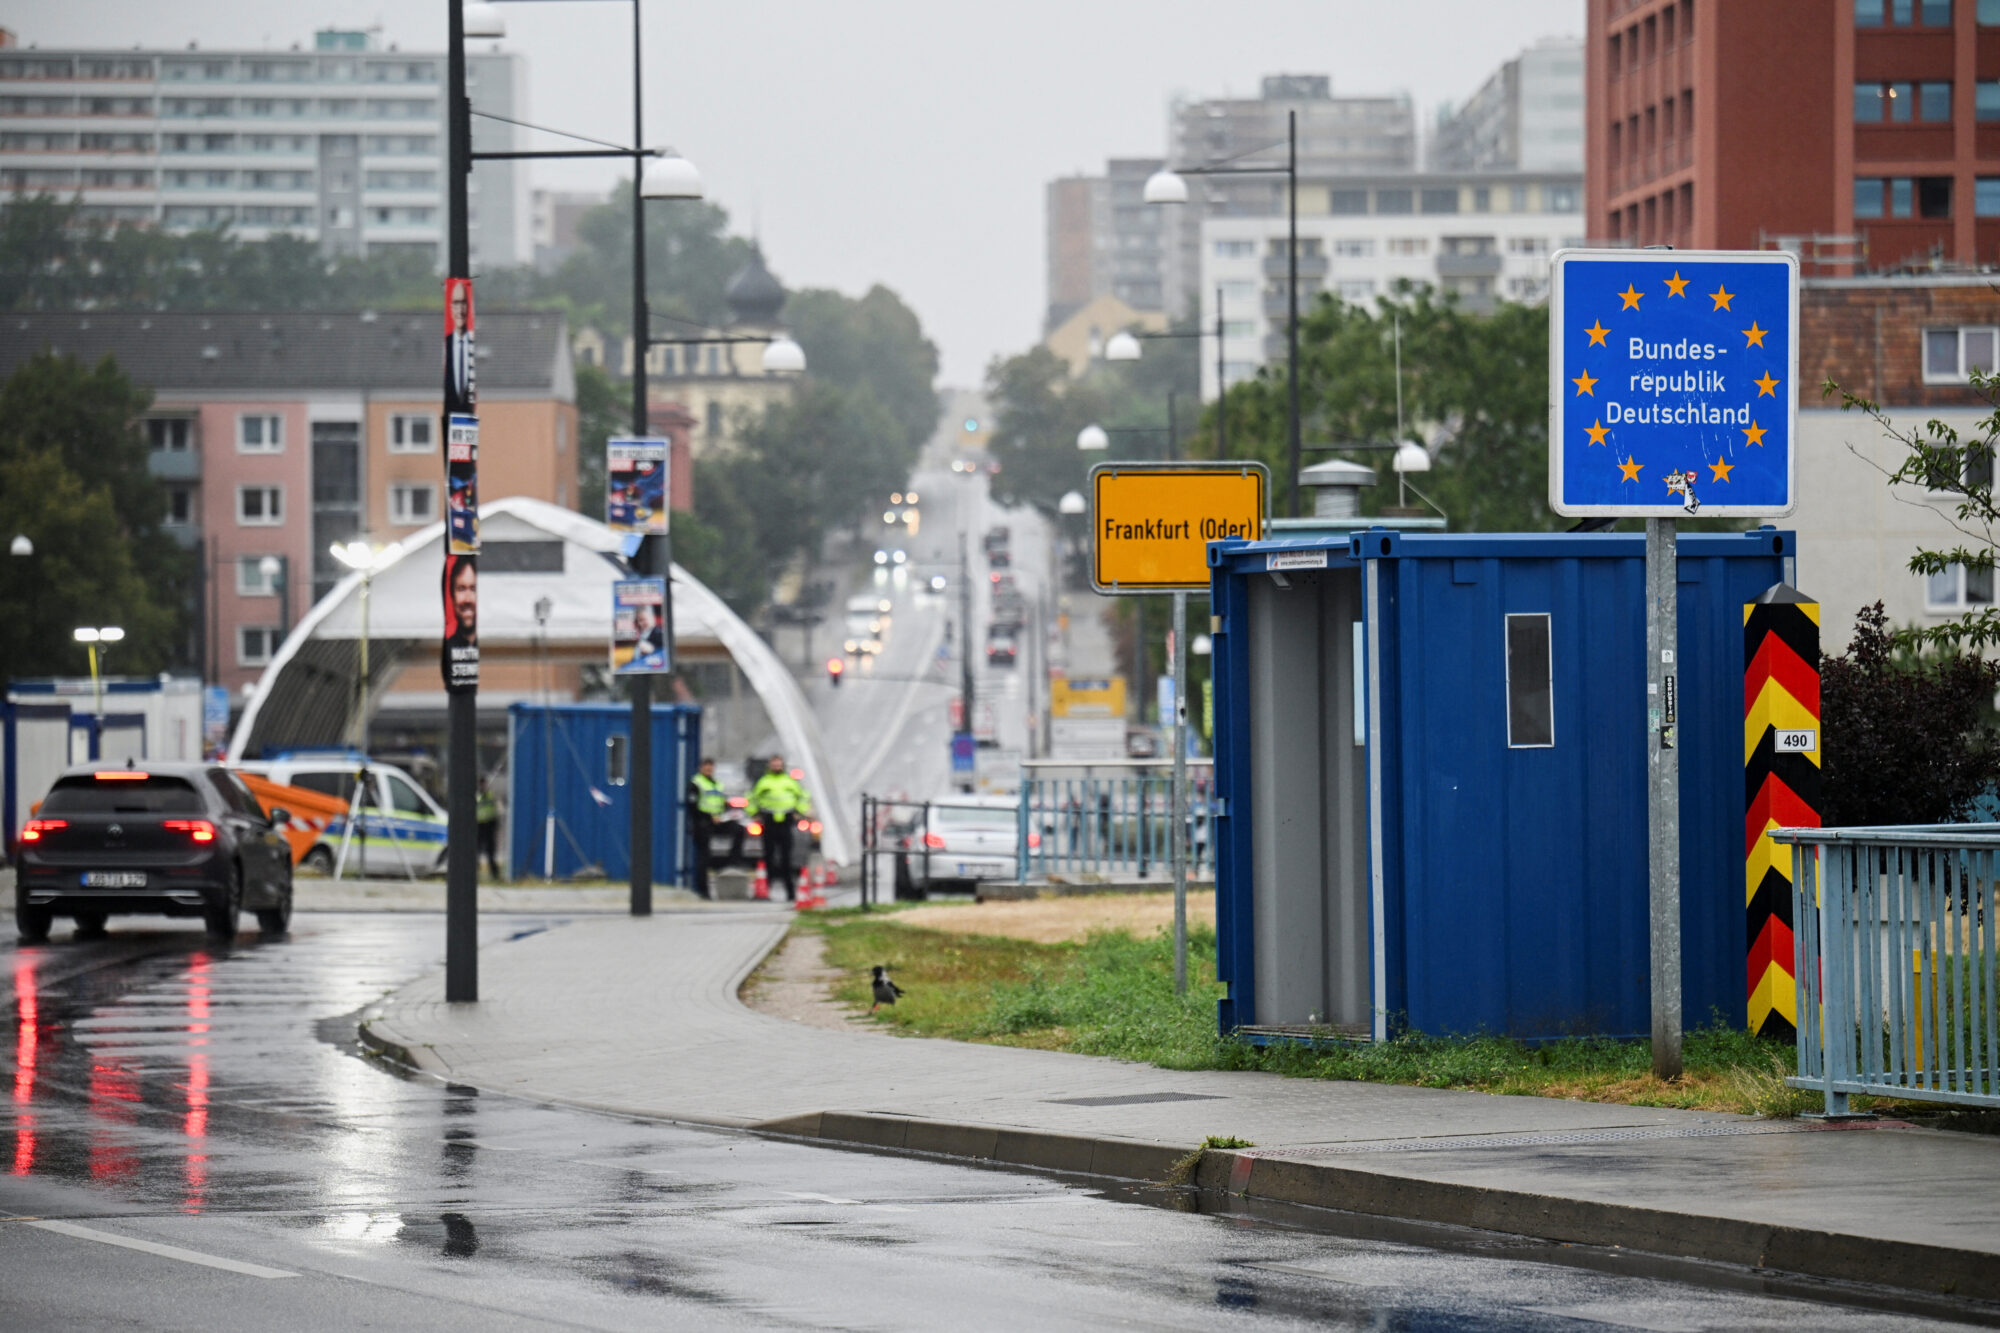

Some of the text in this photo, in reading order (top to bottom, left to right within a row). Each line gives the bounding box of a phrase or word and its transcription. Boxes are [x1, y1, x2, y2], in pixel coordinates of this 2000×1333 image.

[1629, 337, 1728, 360] Bundes-
[1630, 370, 1726, 397] republik
[1606, 401, 1749, 425] Deutschland
[1105, 518, 1253, 540] Frankfurt (Oder)
[1784, 734, 1807, 747] 490
